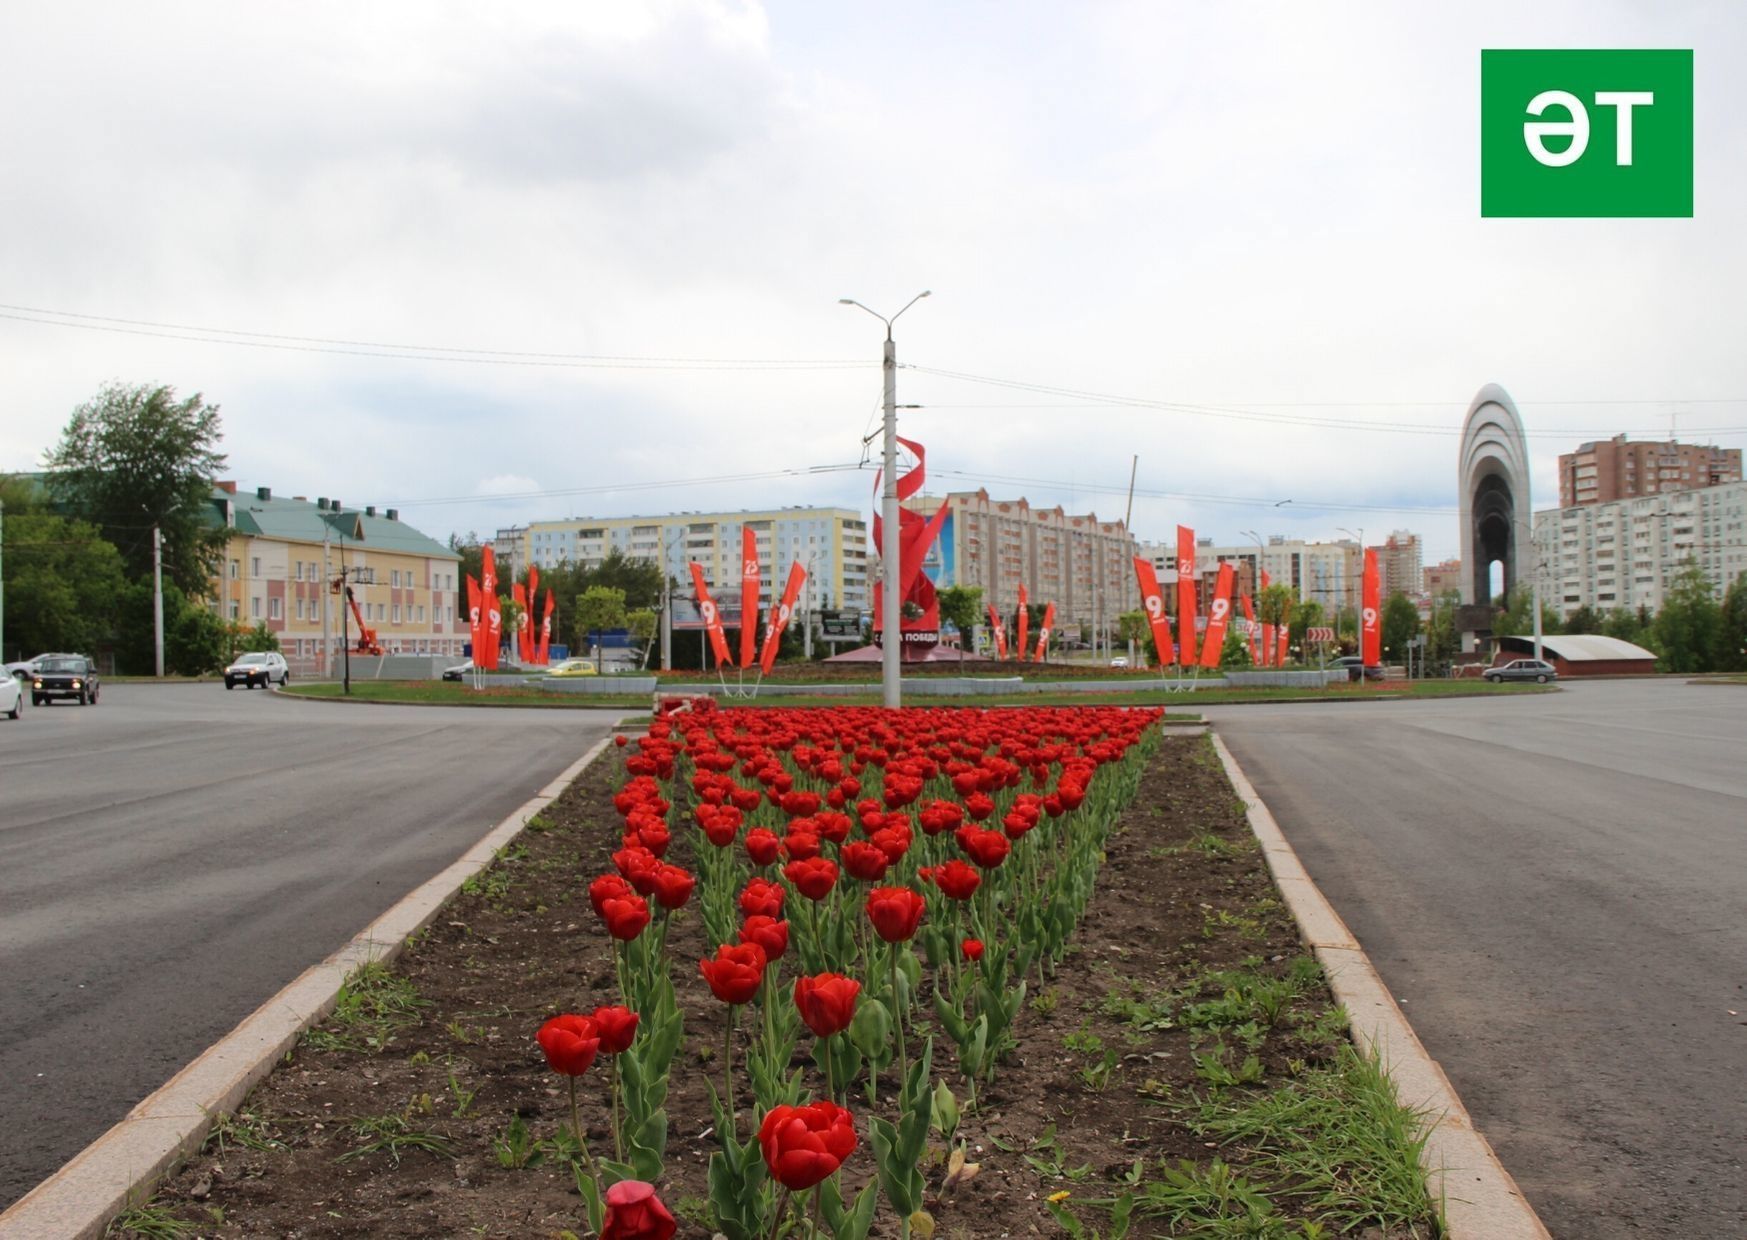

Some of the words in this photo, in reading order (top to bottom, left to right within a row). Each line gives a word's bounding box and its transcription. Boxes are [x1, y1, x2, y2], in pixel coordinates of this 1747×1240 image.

[470, 607, 480, 626] 9
[701, 600, 715, 624] 9
[1145, 595, 1162, 619] 9
[1212, 598, 1229, 620] 9
[1362, 607, 1376, 627] 9
[489, 608, 501, 628] 9
